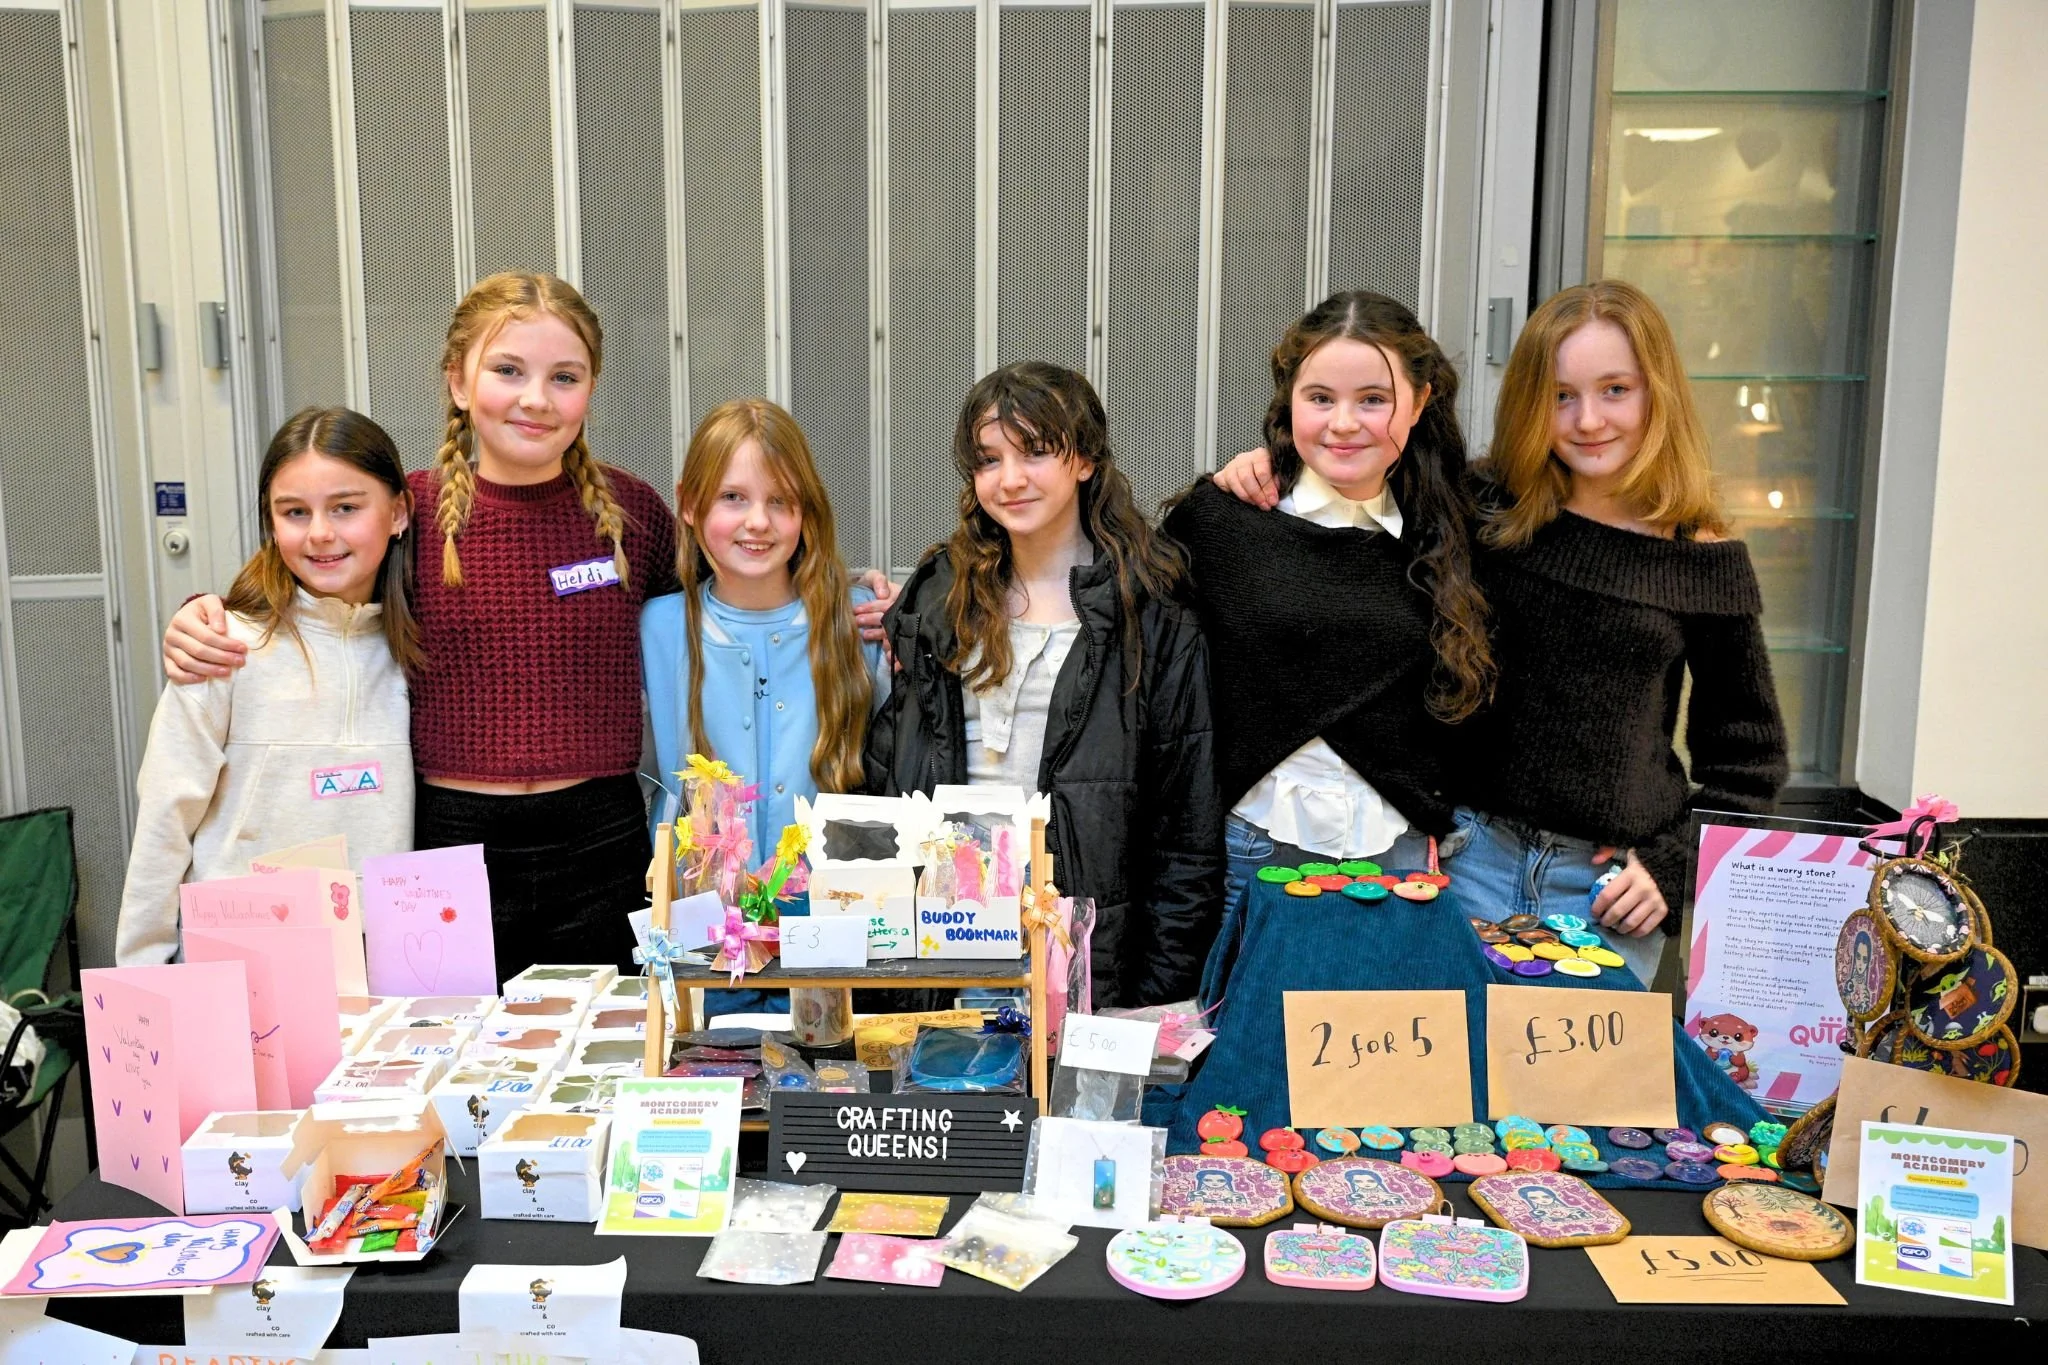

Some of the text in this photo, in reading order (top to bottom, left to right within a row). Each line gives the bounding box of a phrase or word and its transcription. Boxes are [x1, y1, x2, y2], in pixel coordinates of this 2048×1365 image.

[1731, 861, 1755, 870] What
[1777, 867, 1802, 878] worry
[1806, 868, 1836, 878] stone?
[921, 911, 976, 925] BUDDY
[868, 927, 898, 938] etters
[946, 928, 1018, 942] BOOKMARK
[1310, 1021, 1333, 1067] 2
[1412, 1017, 1433, 1057] 5
[1525, 1010, 1624, 1065] £3.00
[837, 1106, 953, 1132] CRAFTING
[847, 1134, 948, 1160] QUEENS!
[1640, 1248, 1763, 1275] £5.00
[532, 1303, 547, 1311] clay
